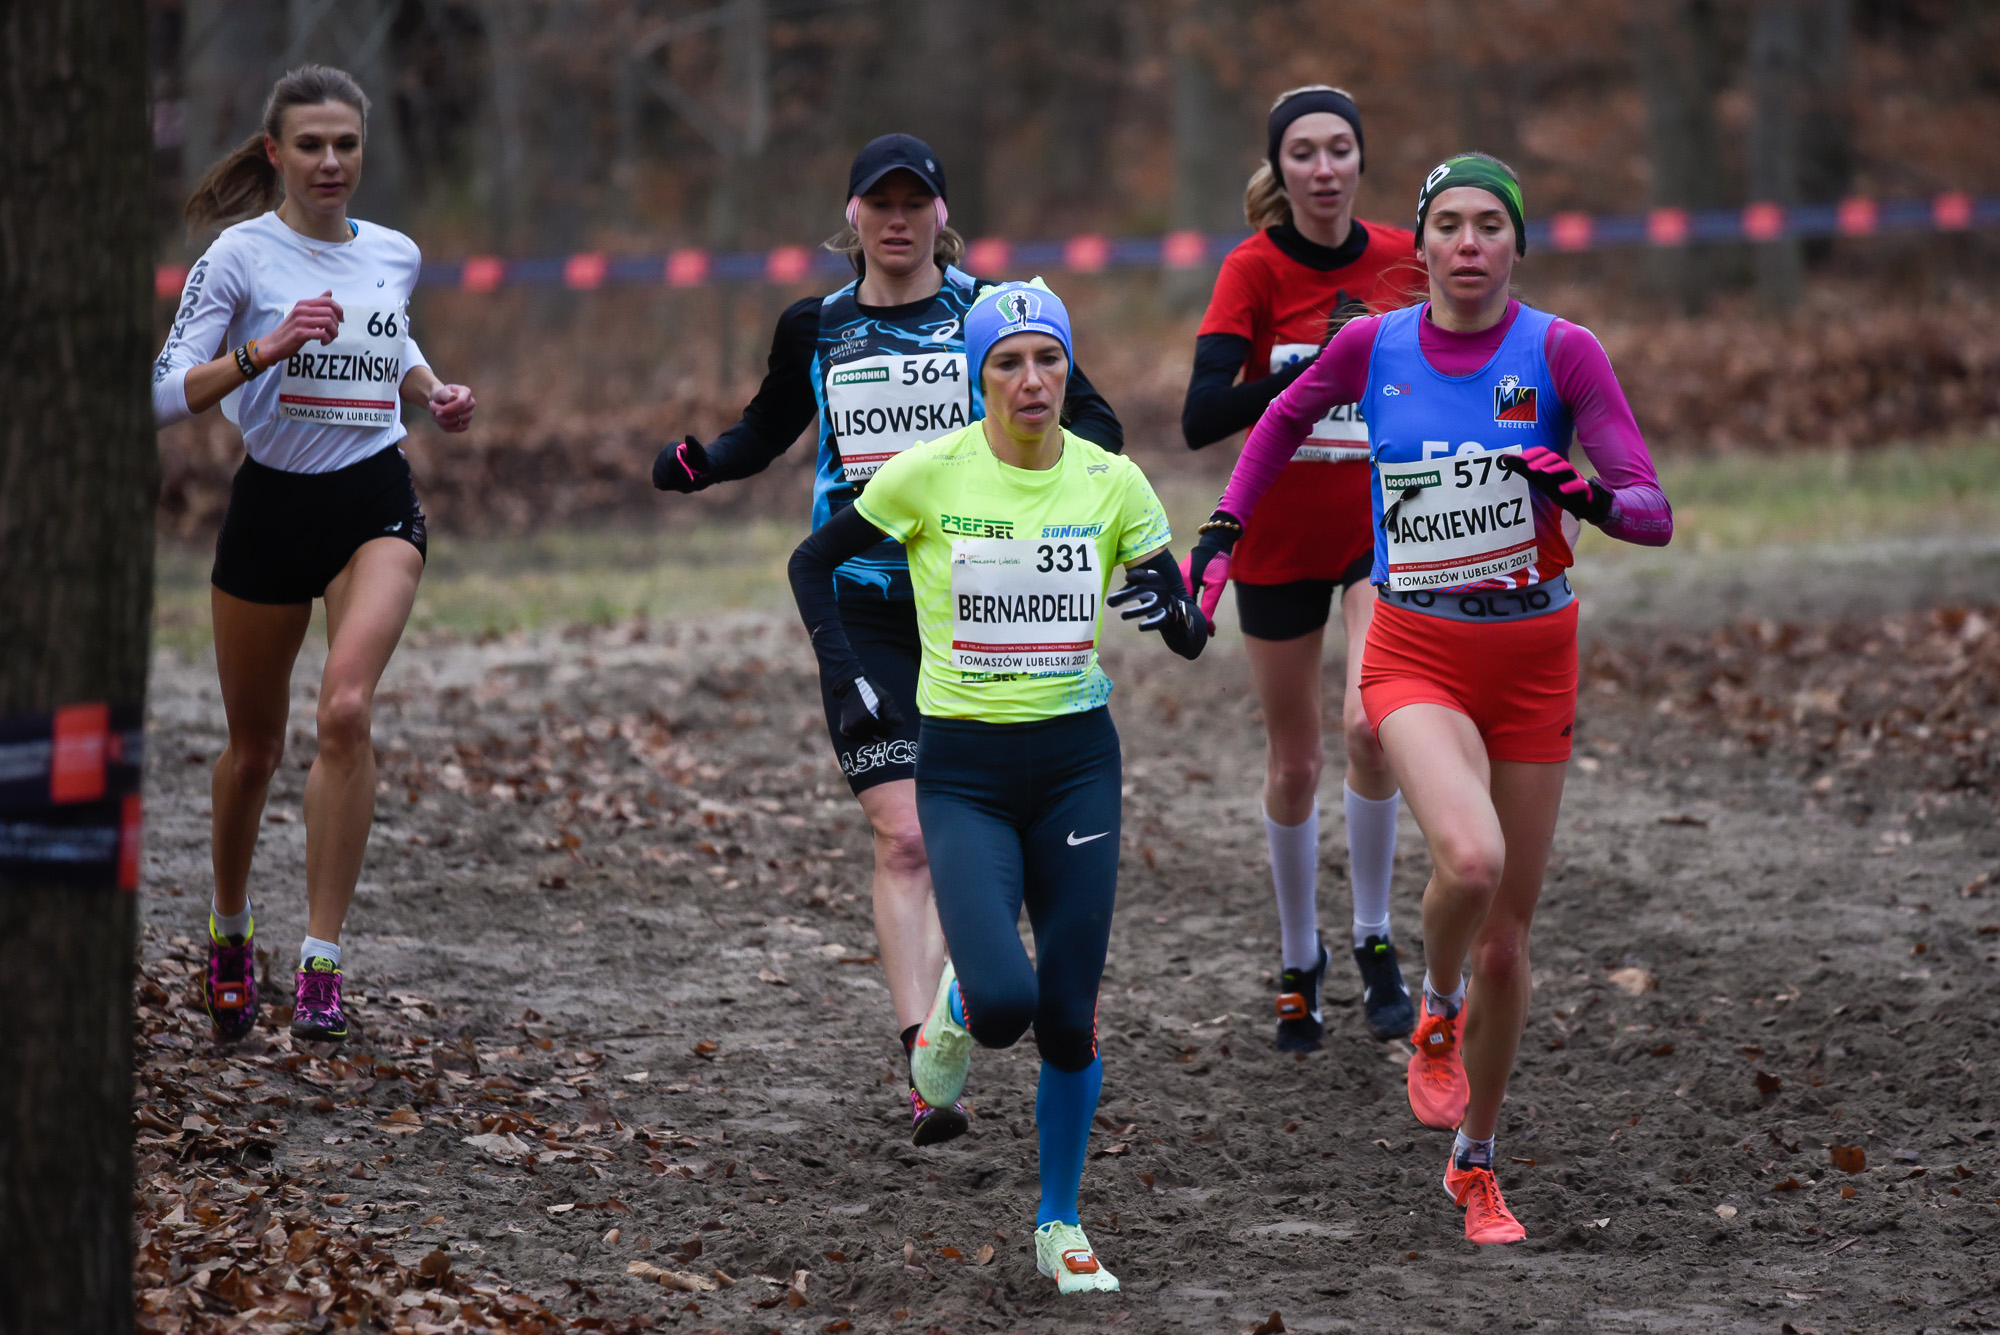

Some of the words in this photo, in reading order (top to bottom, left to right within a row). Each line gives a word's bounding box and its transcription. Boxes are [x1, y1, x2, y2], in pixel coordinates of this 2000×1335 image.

[367, 312, 398, 338] 66
[287, 351, 399, 384] BRZEZIŃSKA
[835, 369, 887, 383] BOGDANKA
[902, 359, 960, 386] 564
[285, 406, 343, 420] TOMASZÓW
[834, 402, 966, 437] LISOWSKA
[1454, 454, 1513, 489] 579
[1393, 498, 1526, 544] JACKIEWICZ
[1036, 543, 1092, 573] 331
[1398, 572, 1459, 586] TOMASZÓW
[1463, 562, 1508, 580] LUBELSKI
[1510, 553, 1532, 568] 2021
[958, 593, 1095, 623] BERNARDELLI
[959, 655, 1022, 668] TOMASZÓW
[1026, 656, 1070, 667] LUBELSKI
[1072, 654, 1088, 666] 2021
